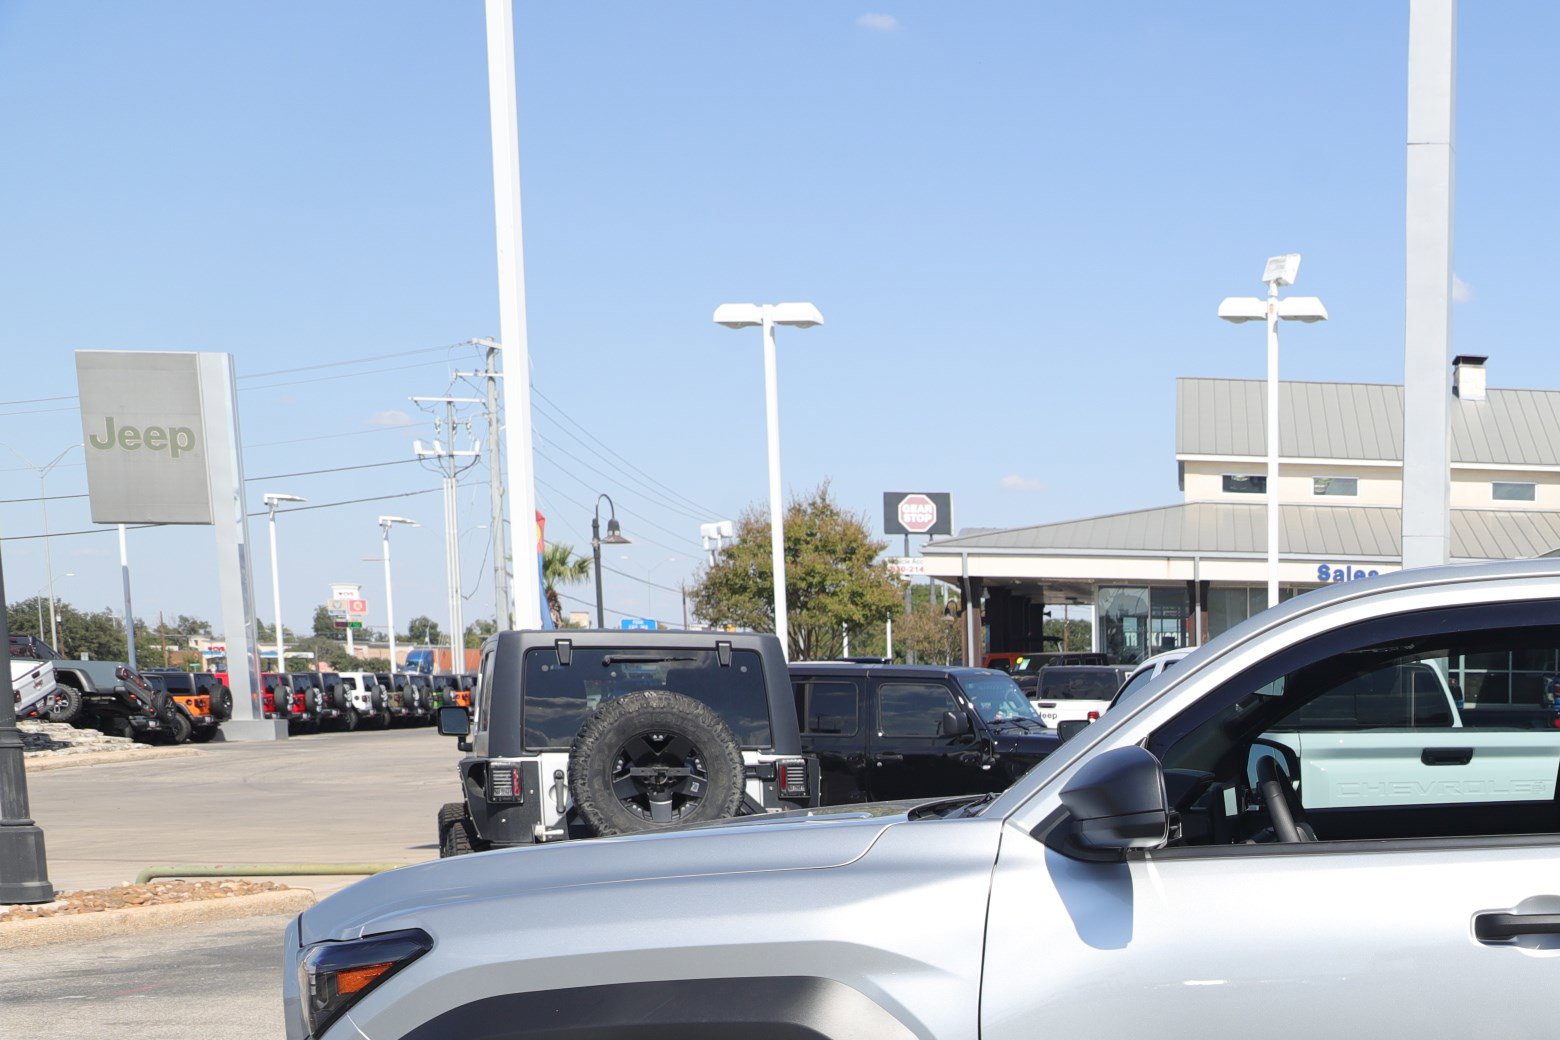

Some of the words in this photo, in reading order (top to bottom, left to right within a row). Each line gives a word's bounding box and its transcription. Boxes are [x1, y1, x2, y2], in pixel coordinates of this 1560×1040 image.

[89, 416, 196, 458] Jeep
[901, 503, 932, 513] GEAR
[903, 513, 932, 523] STOP
